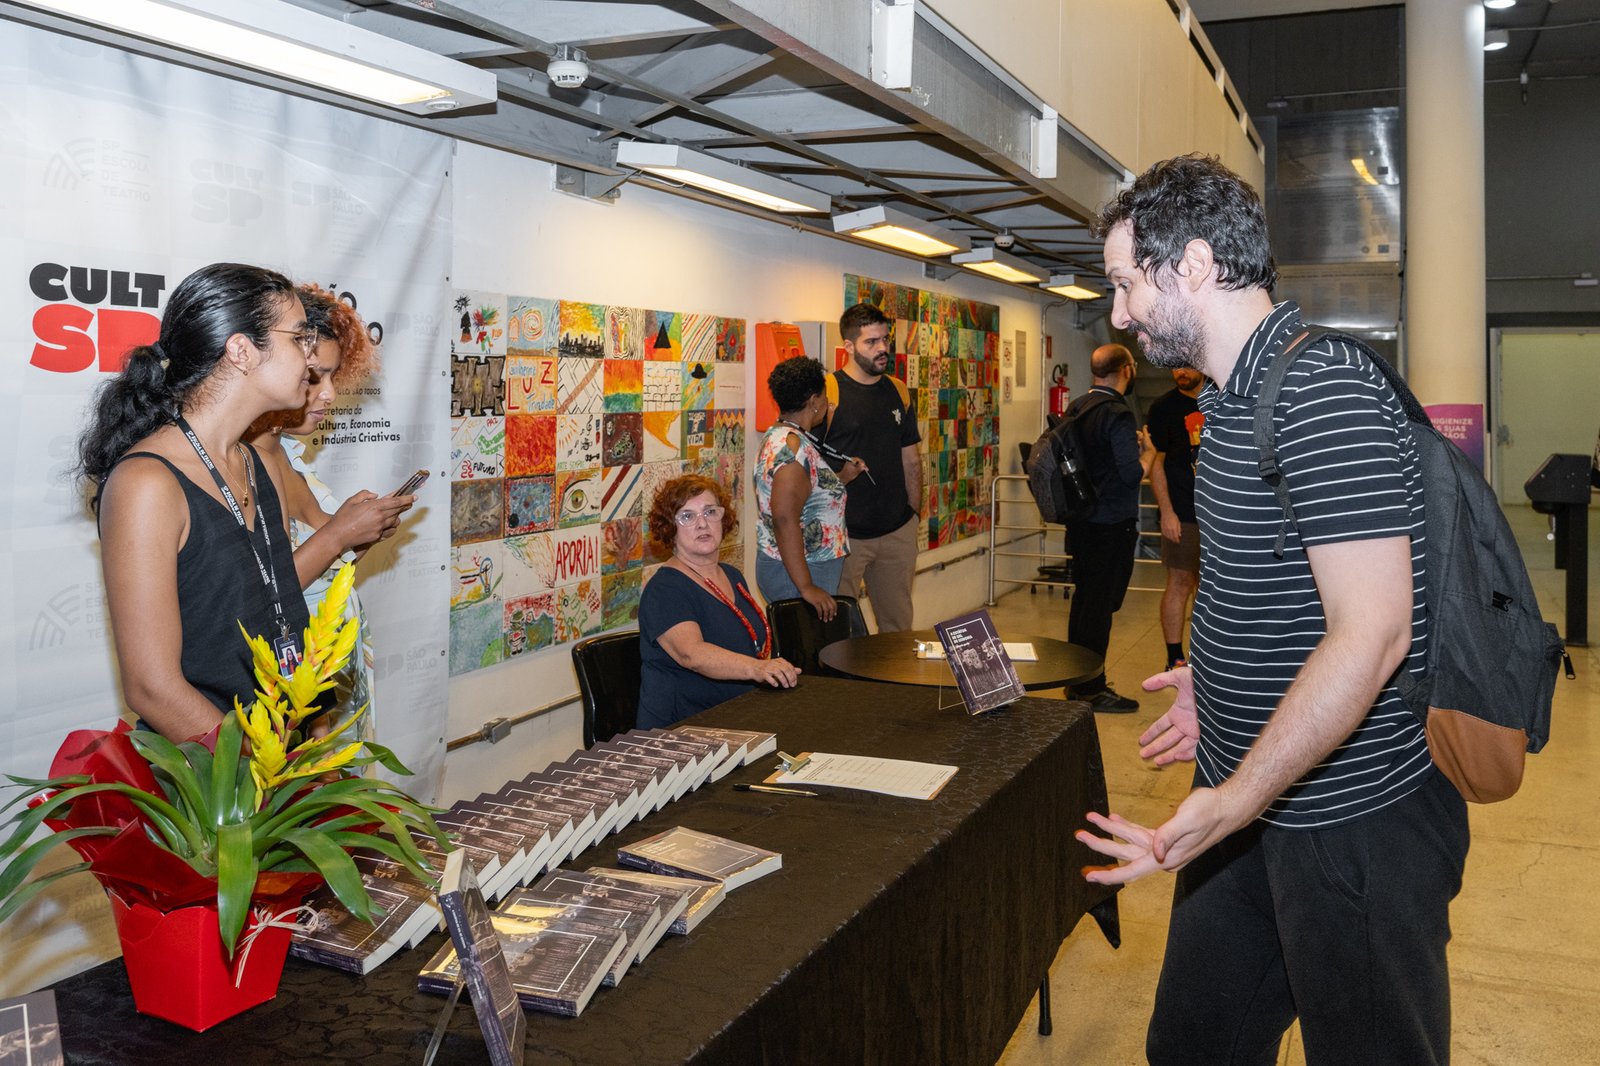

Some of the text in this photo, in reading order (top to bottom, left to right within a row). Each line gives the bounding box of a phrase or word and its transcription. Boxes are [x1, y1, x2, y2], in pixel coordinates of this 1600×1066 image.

[102, 186, 151, 203] TEATRO
[29, 262, 165, 309] CULT
[364, 387, 381, 396] TODOS
[324, 405, 362, 417] cretaria da
[316, 417, 391, 432] ultura, Economia
[312, 431, 401, 446] e Indústria Criativas
[473, 462, 496, 475] FUTURO
[555, 535, 599, 581] APORIA!
